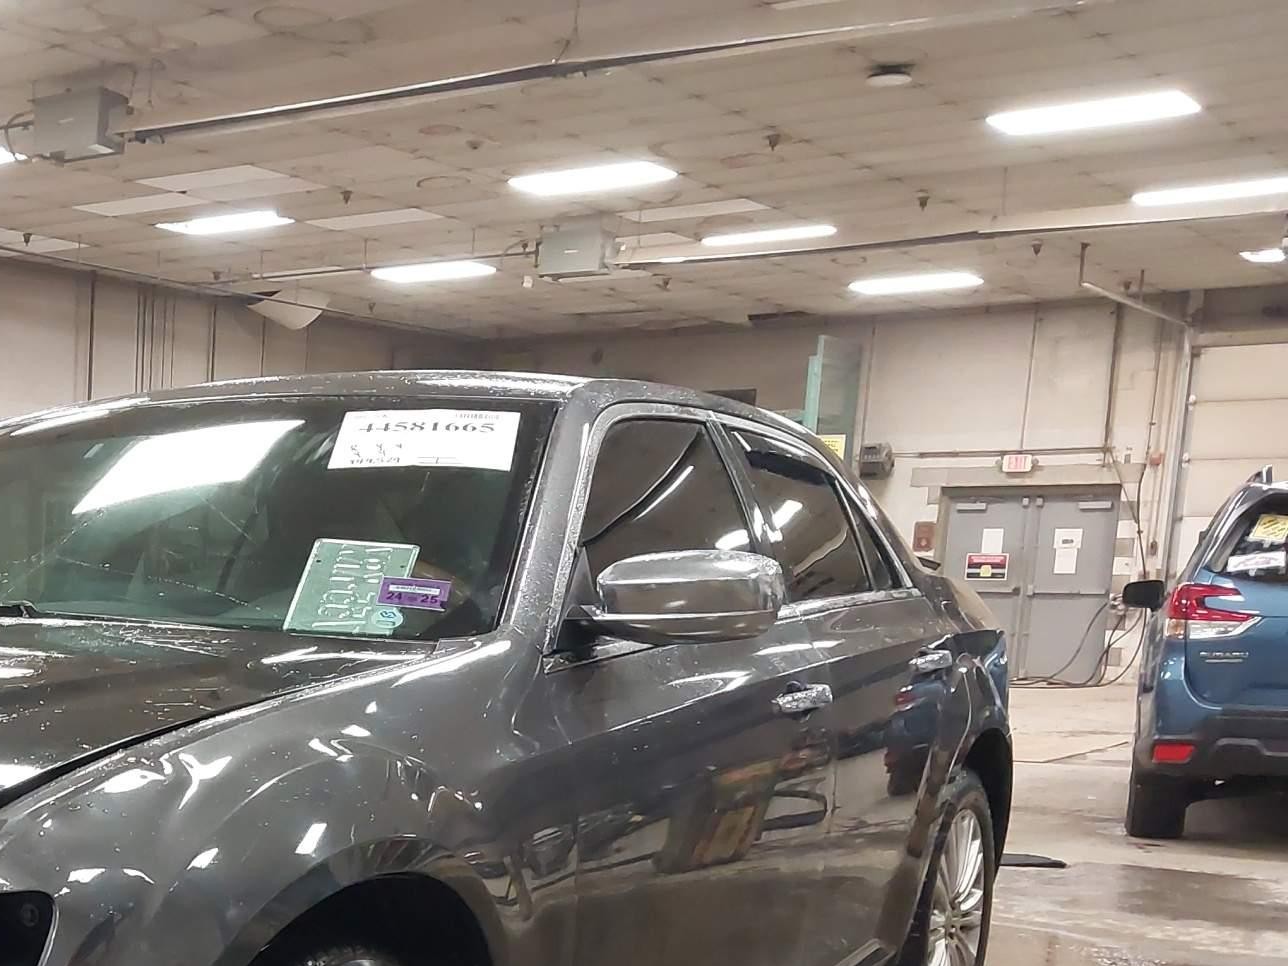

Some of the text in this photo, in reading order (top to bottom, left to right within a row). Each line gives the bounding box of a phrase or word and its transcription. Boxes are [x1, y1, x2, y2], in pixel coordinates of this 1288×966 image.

[359, 422, 495, 433] 44581665
[386, 591, 403, 601] 24
[420, 594, 438, 604] 25
